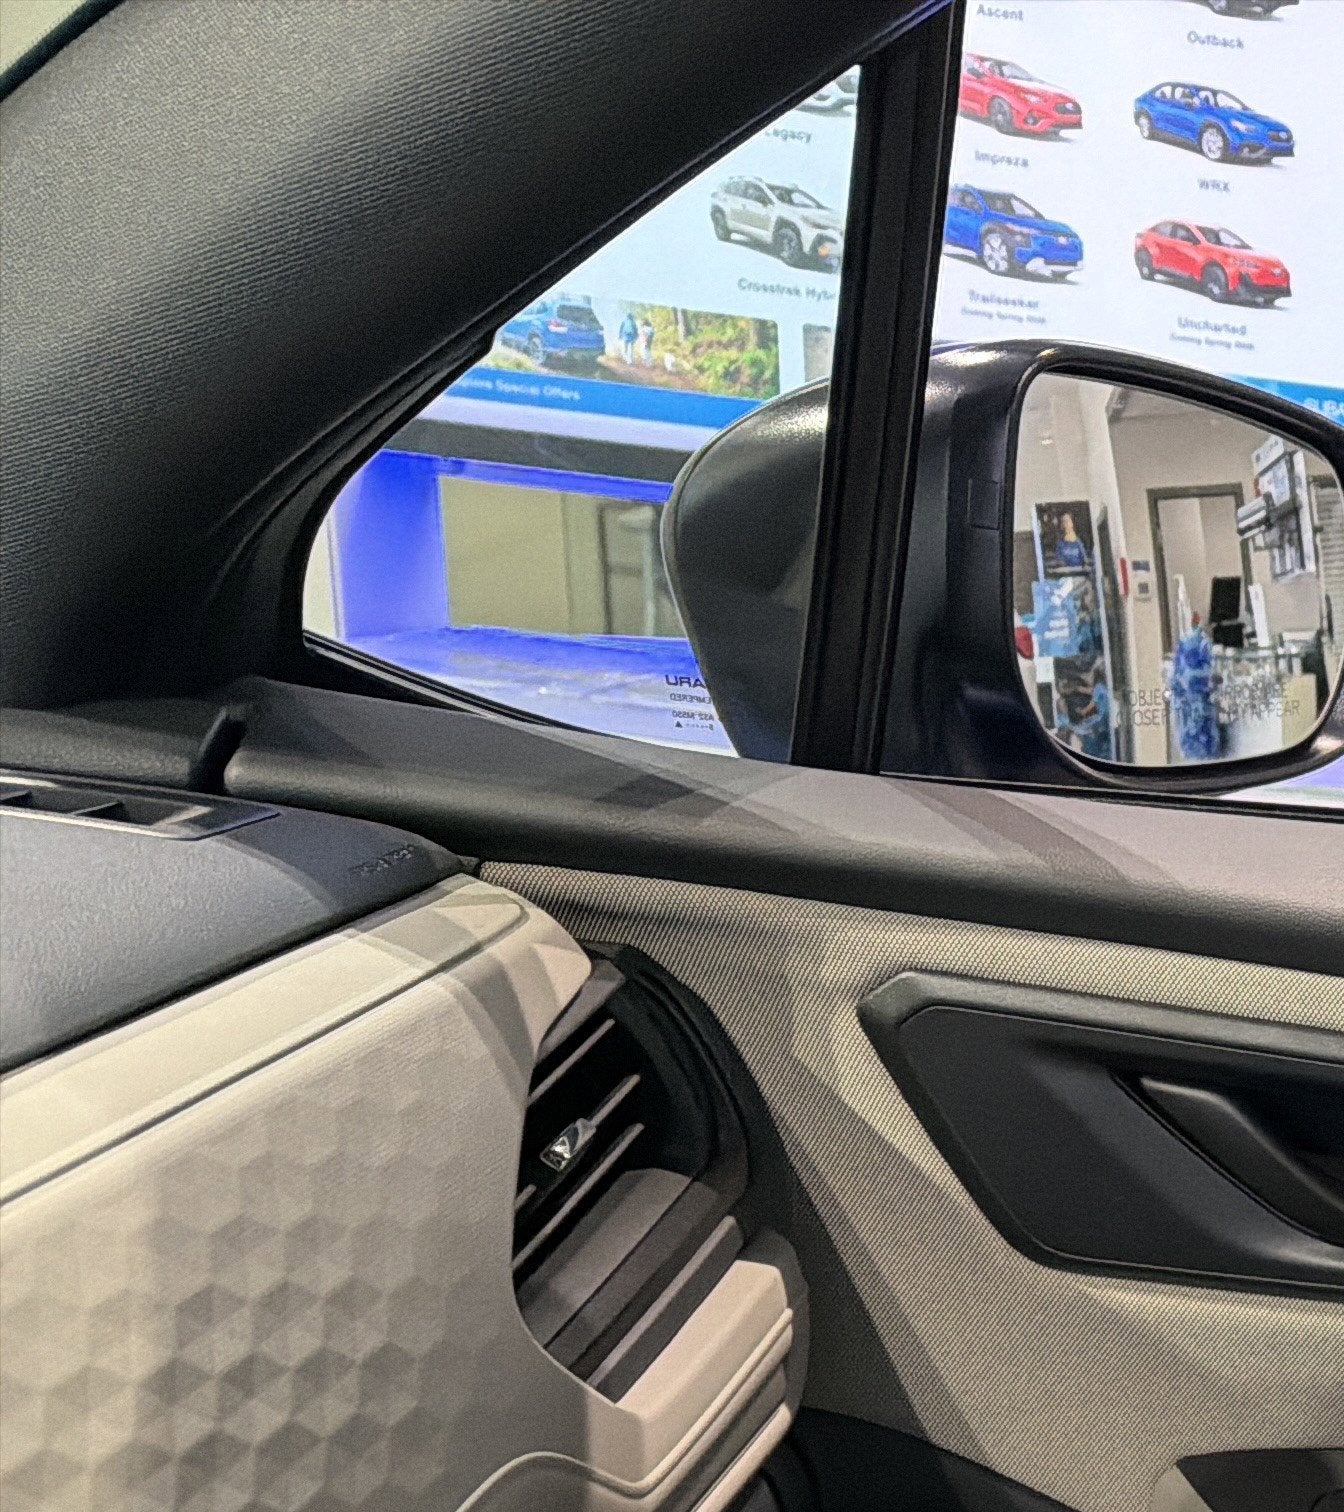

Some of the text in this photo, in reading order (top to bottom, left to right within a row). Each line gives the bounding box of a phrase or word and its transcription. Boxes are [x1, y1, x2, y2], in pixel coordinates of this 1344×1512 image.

[976, 3, 1024, 21] Ascent
[1187, 31, 1244, 49] Outback
[974, 150, 1030, 168] Impreza
[1197, 178, 1231, 193] WRX
[737, 277, 802, 297] Crosstrek
[968, 289, 1040, 309] Trailseeker
